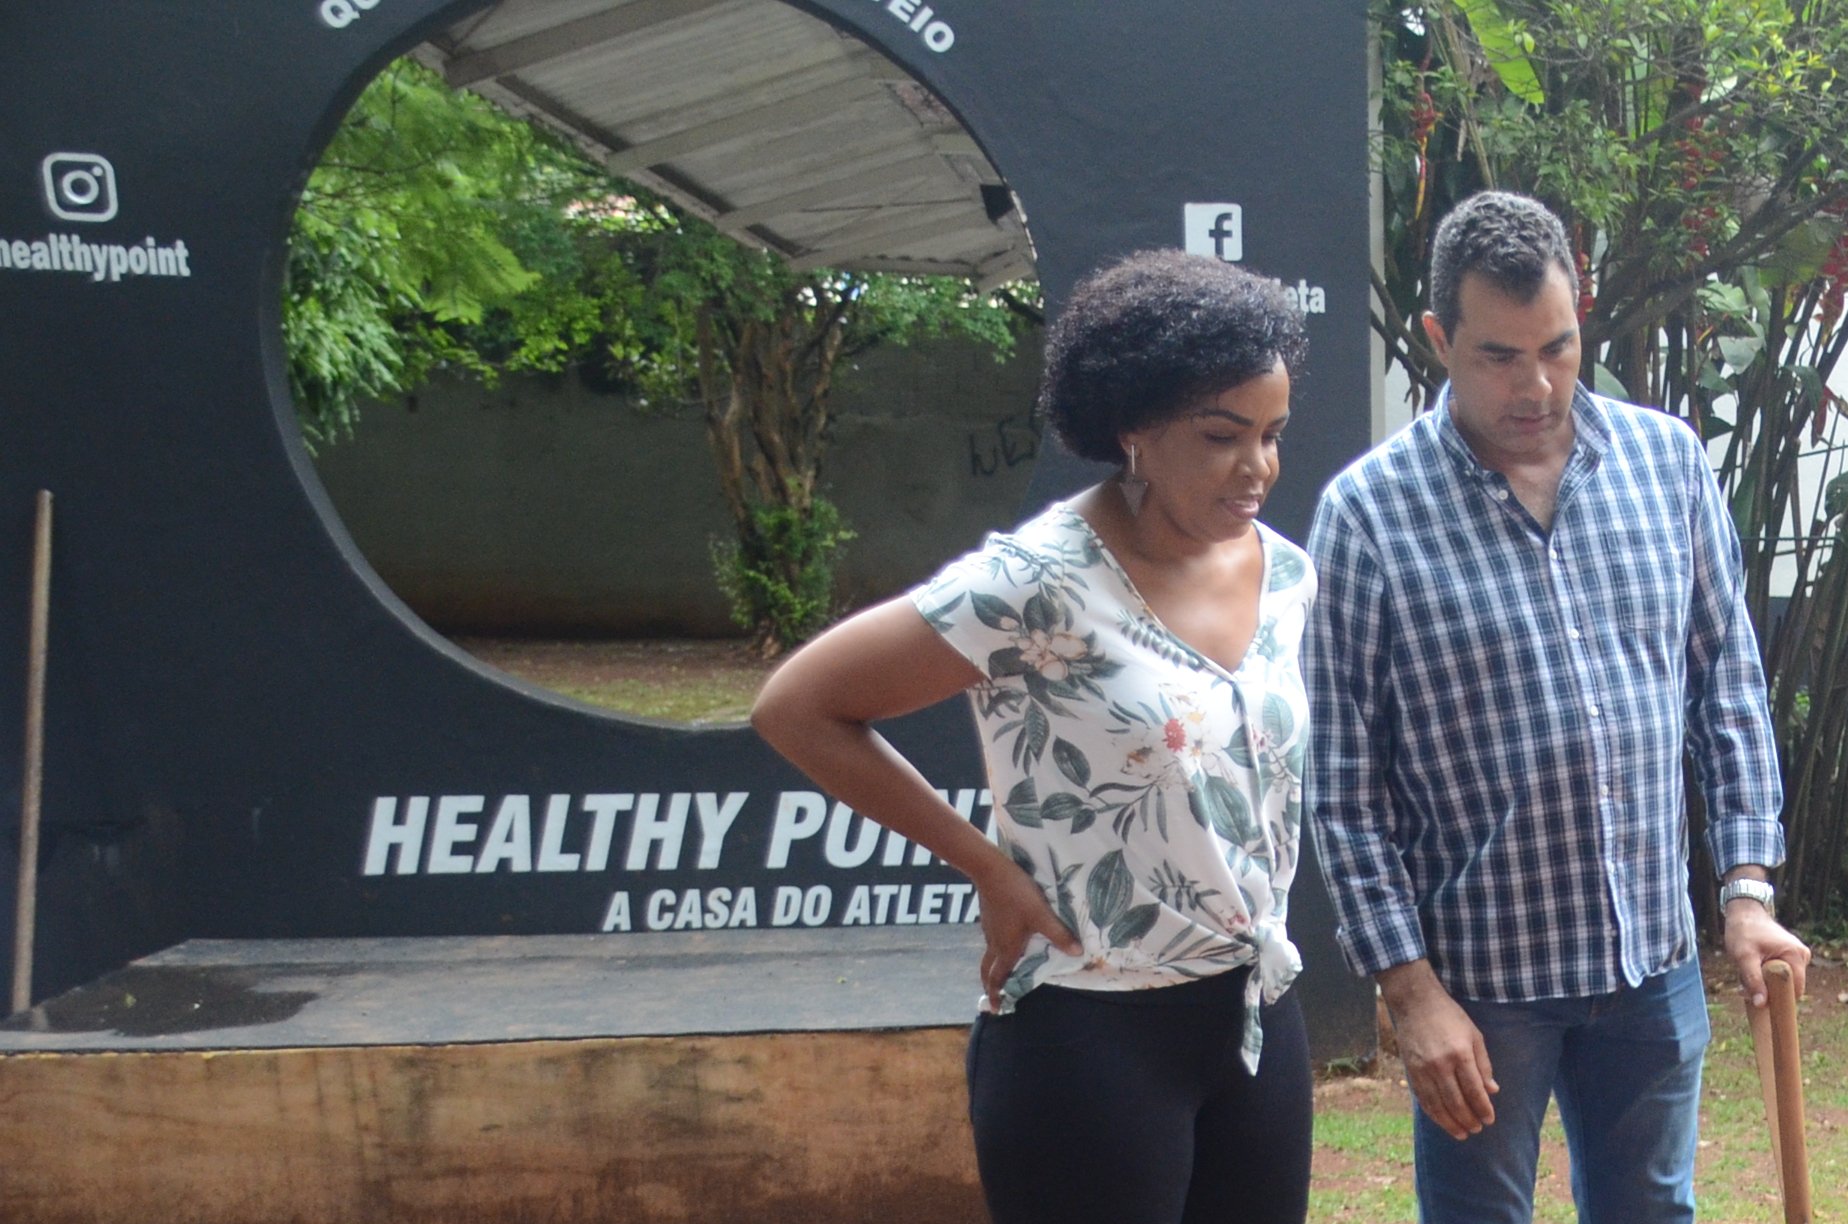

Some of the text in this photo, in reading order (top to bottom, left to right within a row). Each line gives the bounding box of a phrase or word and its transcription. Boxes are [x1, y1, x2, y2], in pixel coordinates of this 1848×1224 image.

[361, 791, 749, 876] HEALTHY
[603, 892, 631, 932] A
[645, 886, 758, 931] CASA
[770, 885, 834, 928] DO
